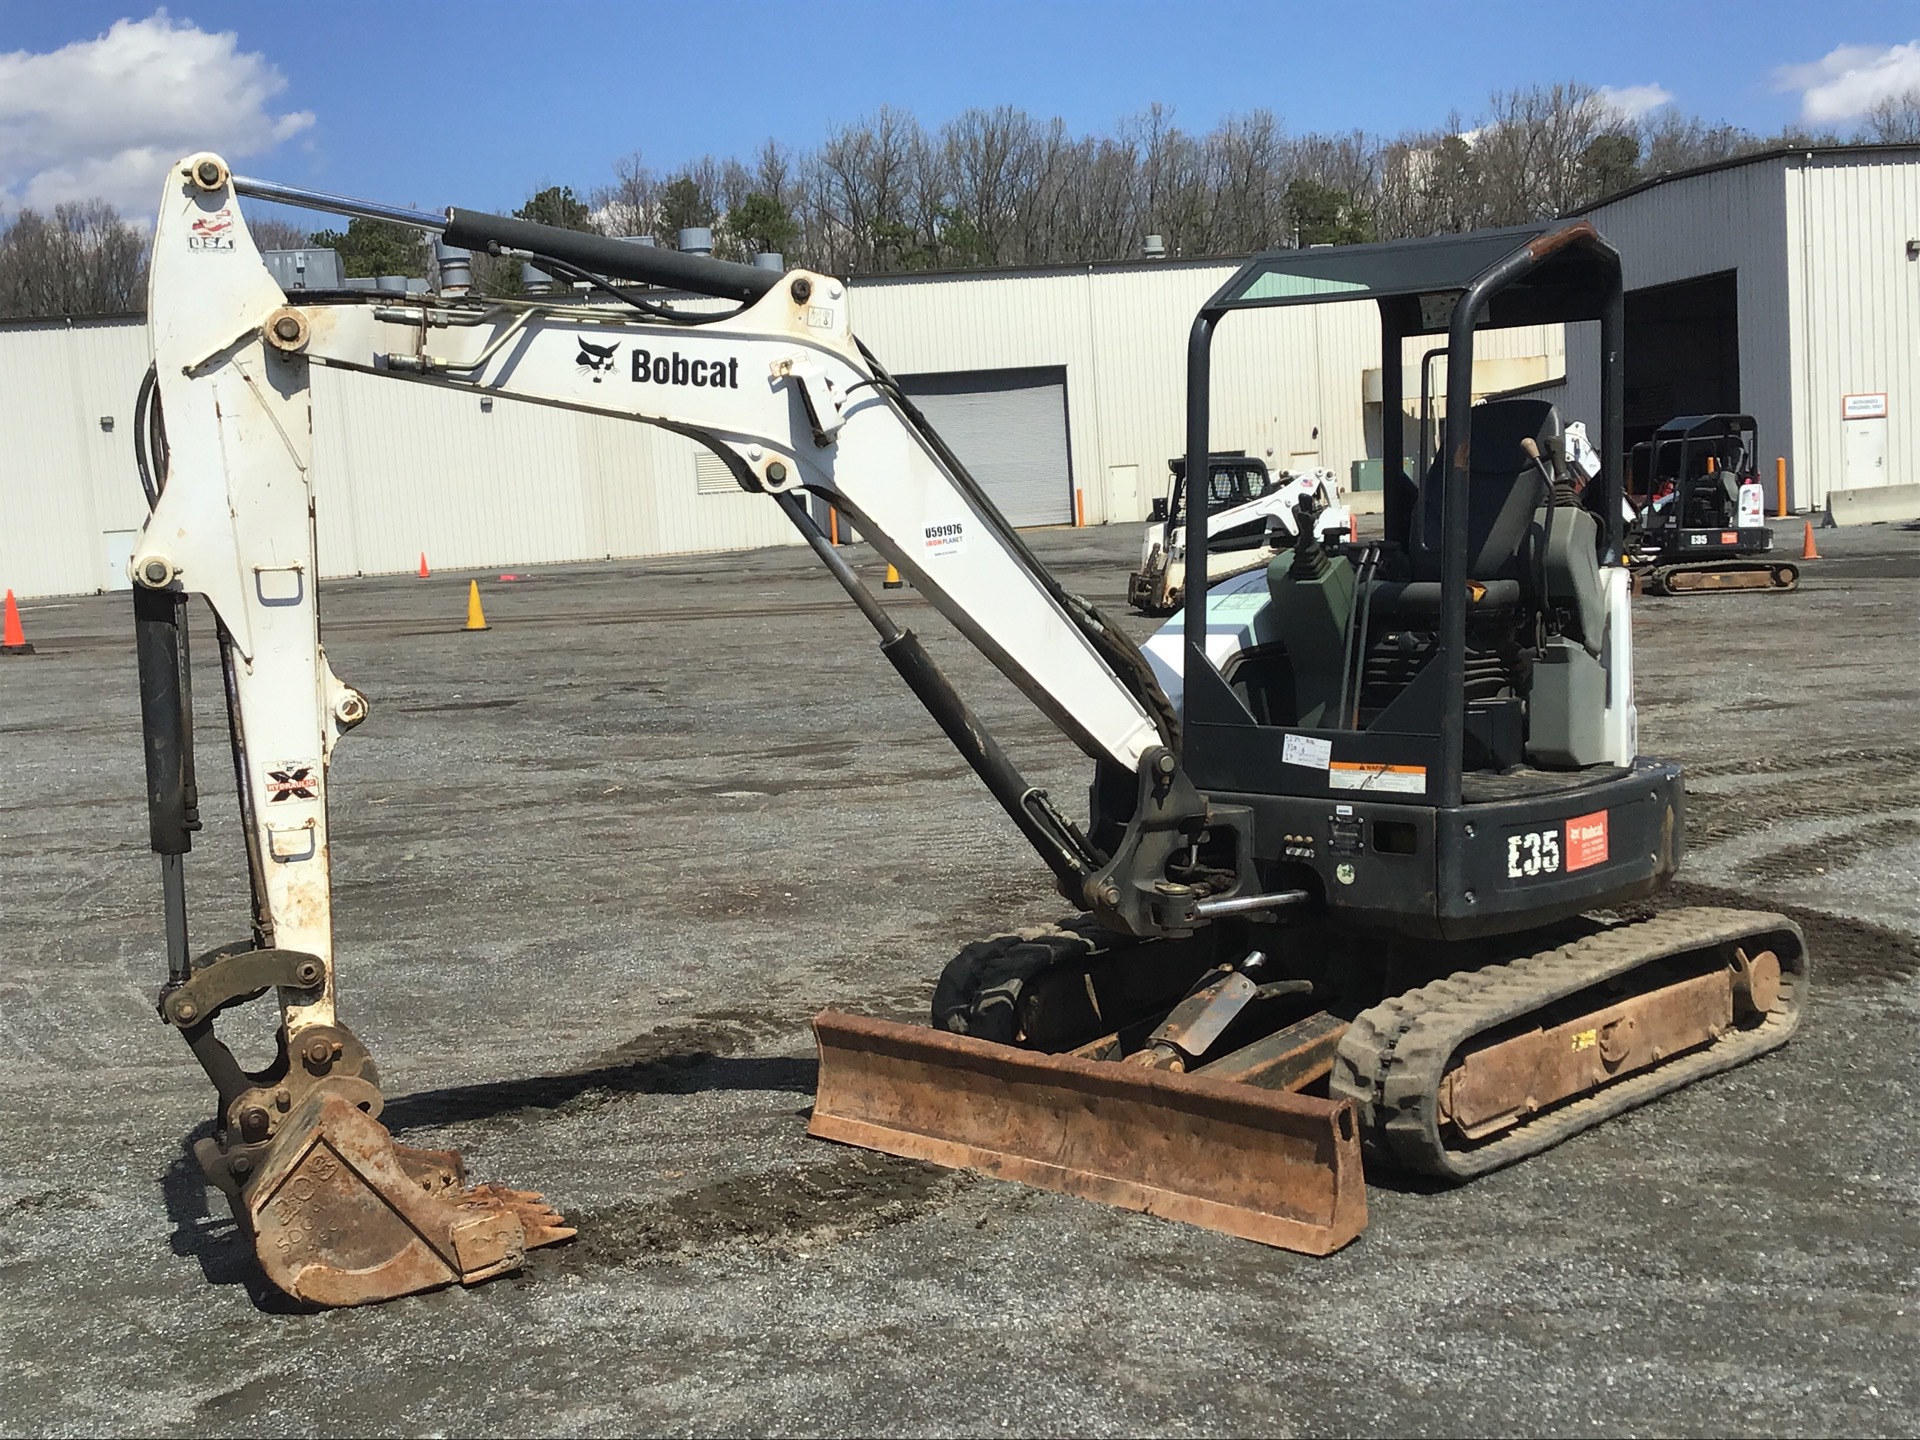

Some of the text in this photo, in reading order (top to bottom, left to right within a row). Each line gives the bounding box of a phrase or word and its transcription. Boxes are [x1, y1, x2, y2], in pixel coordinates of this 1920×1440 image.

[189, 236, 234, 250] USA
[631, 348, 739, 390] Bobcat
[925, 523, 963, 538] U591976
[1690, 534, 1708, 545] E35
[268, 779, 315, 792] HYDRAULIC
[1507, 829, 1560, 878] E35
